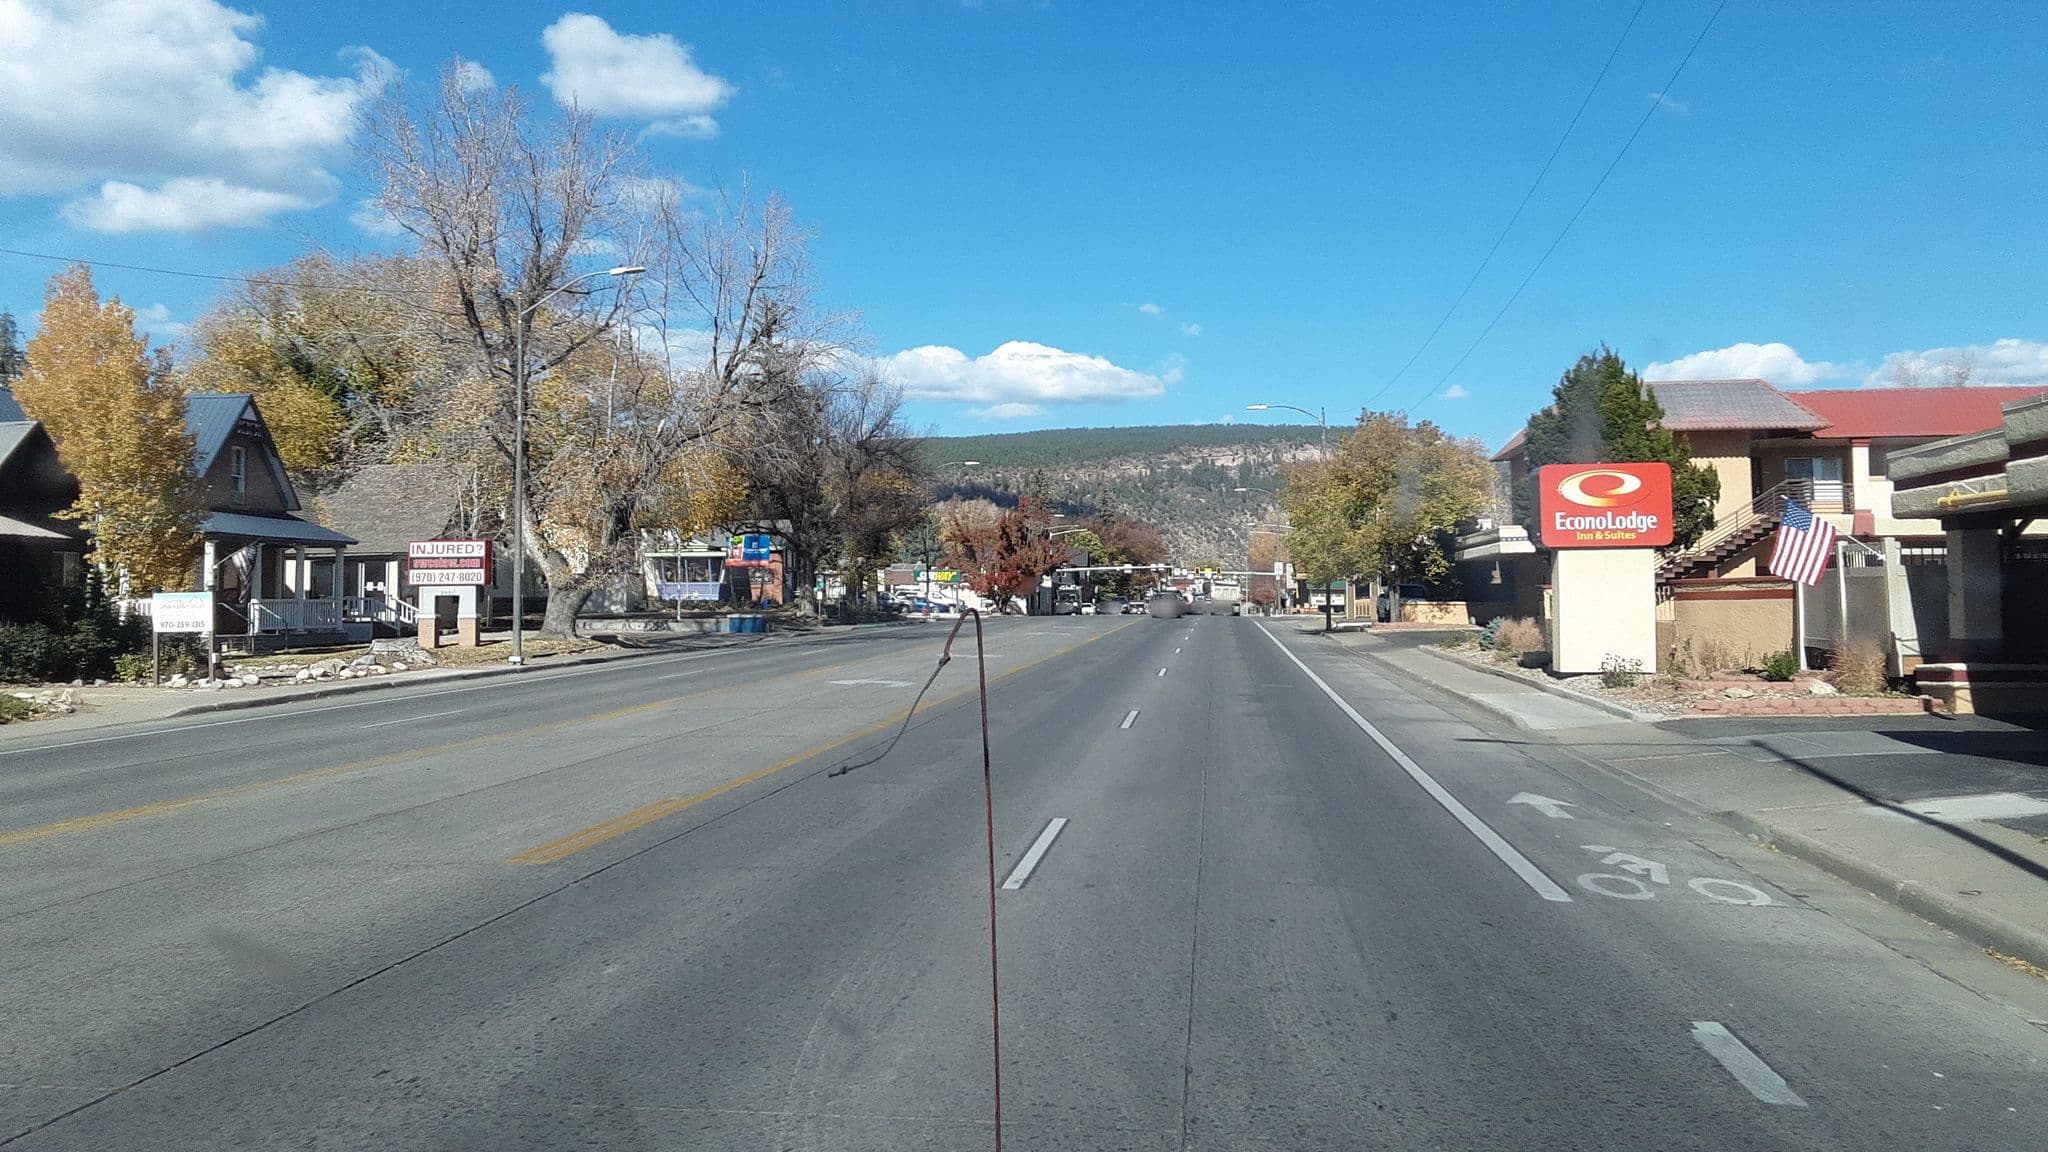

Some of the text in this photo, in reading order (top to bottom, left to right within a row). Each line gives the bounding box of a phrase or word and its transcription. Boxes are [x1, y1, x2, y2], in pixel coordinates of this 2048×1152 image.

[1555, 511, 1658, 533] EconoLodge
[1576, 530, 1637, 540] Inn & Suites
[411, 544, 483, 555] INJURED?
[411, 572, 482, 583] (970) 247-8020
